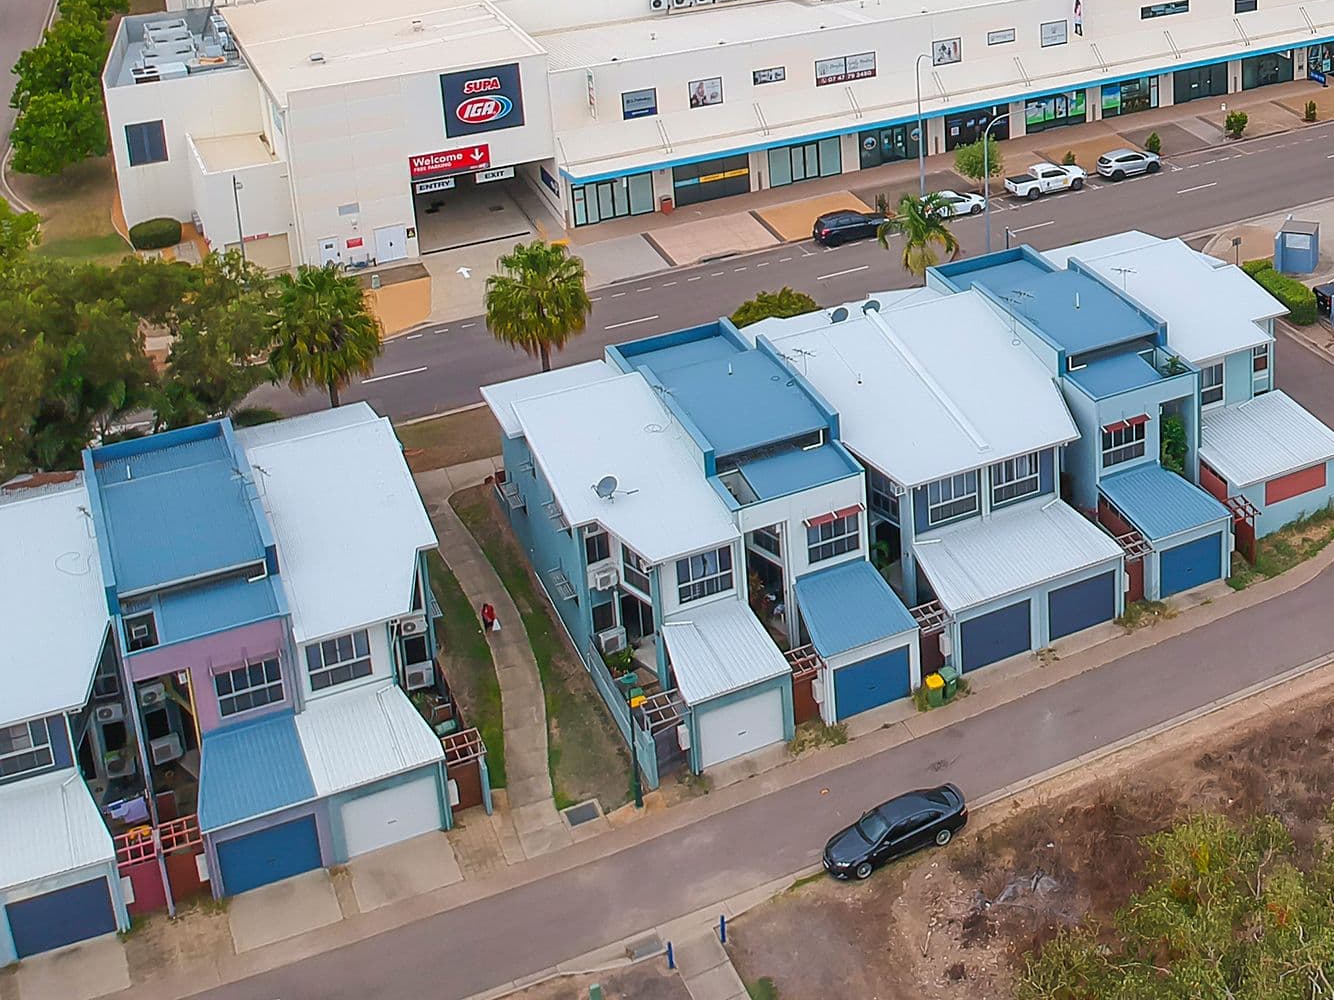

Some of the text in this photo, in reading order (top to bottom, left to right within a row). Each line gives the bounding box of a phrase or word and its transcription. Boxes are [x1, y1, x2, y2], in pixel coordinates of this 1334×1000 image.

[464, 77, 500, 94] SUPA
[463, 101, 496, 119] IGA
[413, 153, 463, 167] Welcome
[428, 162, 452, 171] PARKING
[485, 170, 505, 179] EXIT
[420, 180, 450, 191] ENTRY
